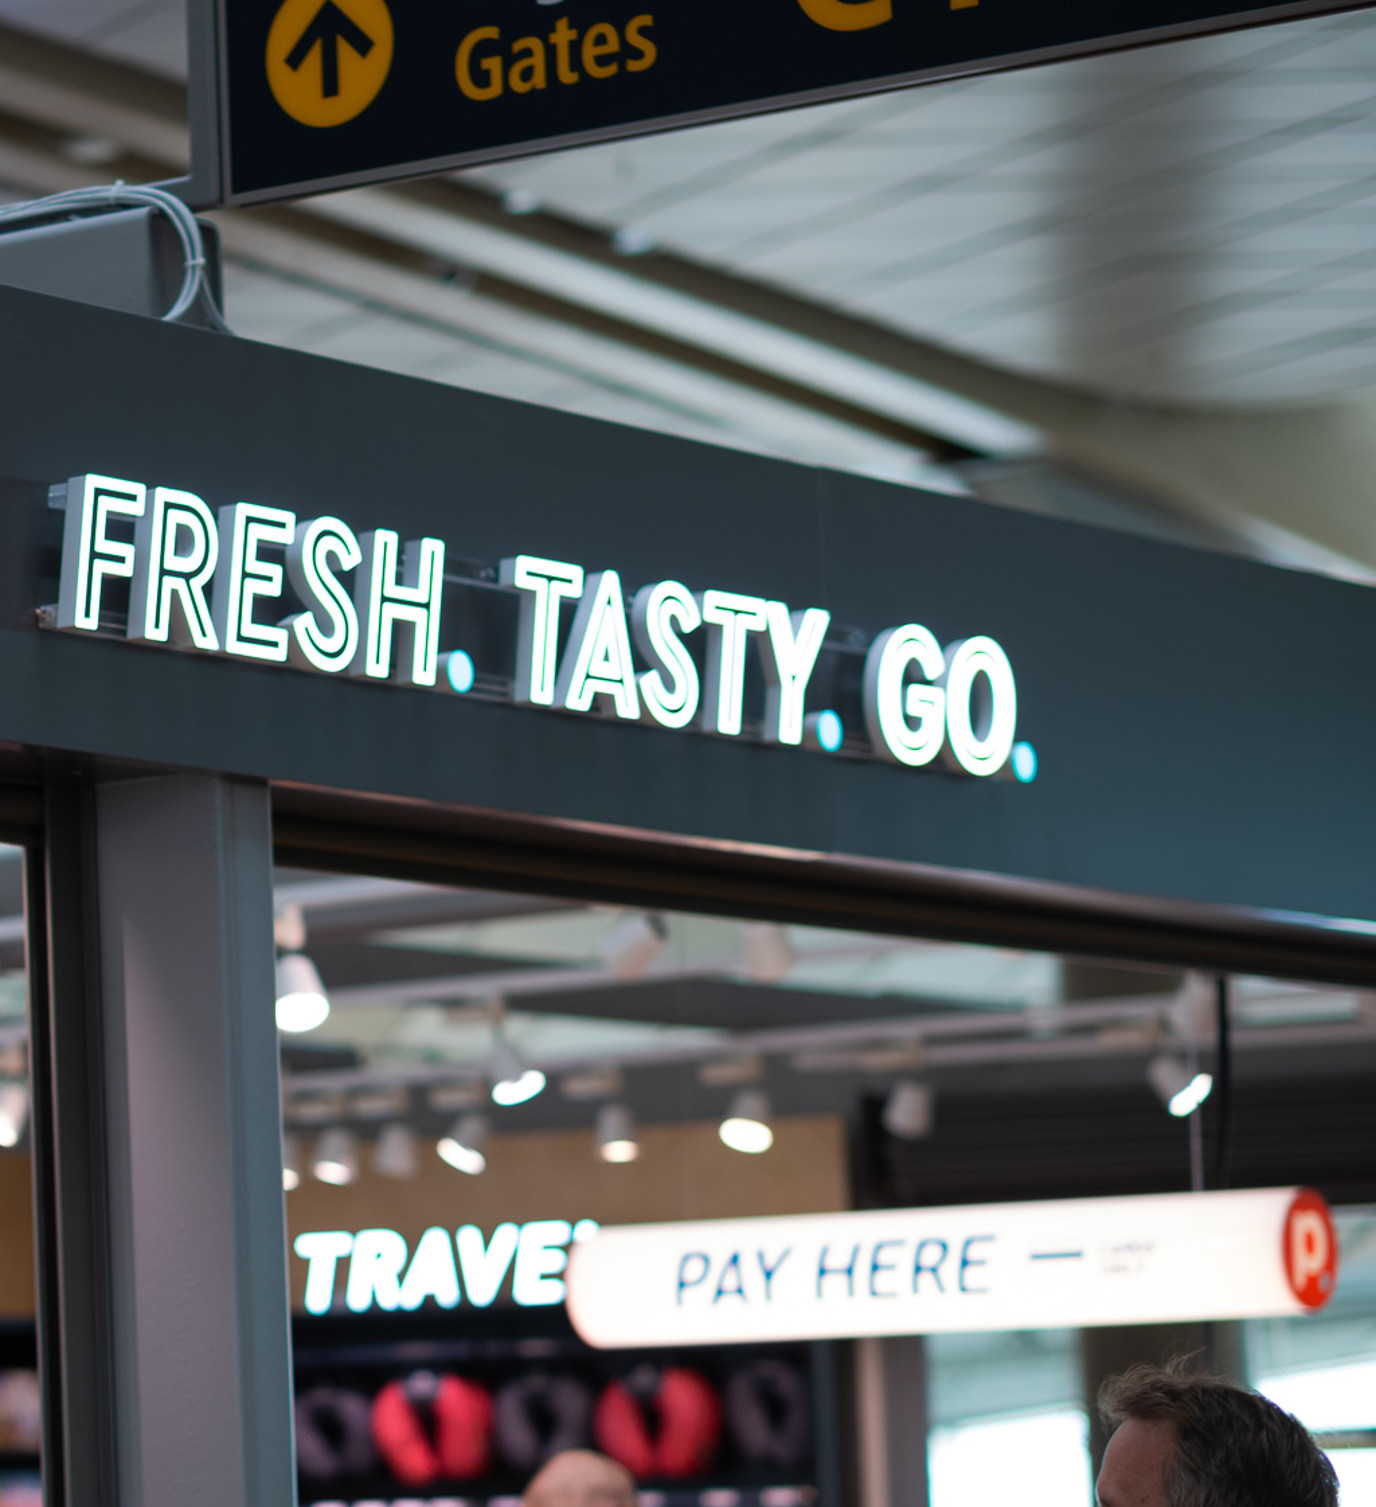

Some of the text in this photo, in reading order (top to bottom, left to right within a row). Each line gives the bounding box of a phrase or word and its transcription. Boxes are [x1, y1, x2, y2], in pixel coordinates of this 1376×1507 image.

[454, 14, 657, 101] Gates
[70, 473, 1037, 783] FRESH. TASTY. GO.
[294, 1218, 600, 1316] TRAVE
[676, 1234, 997, 1307] PAY HERE
